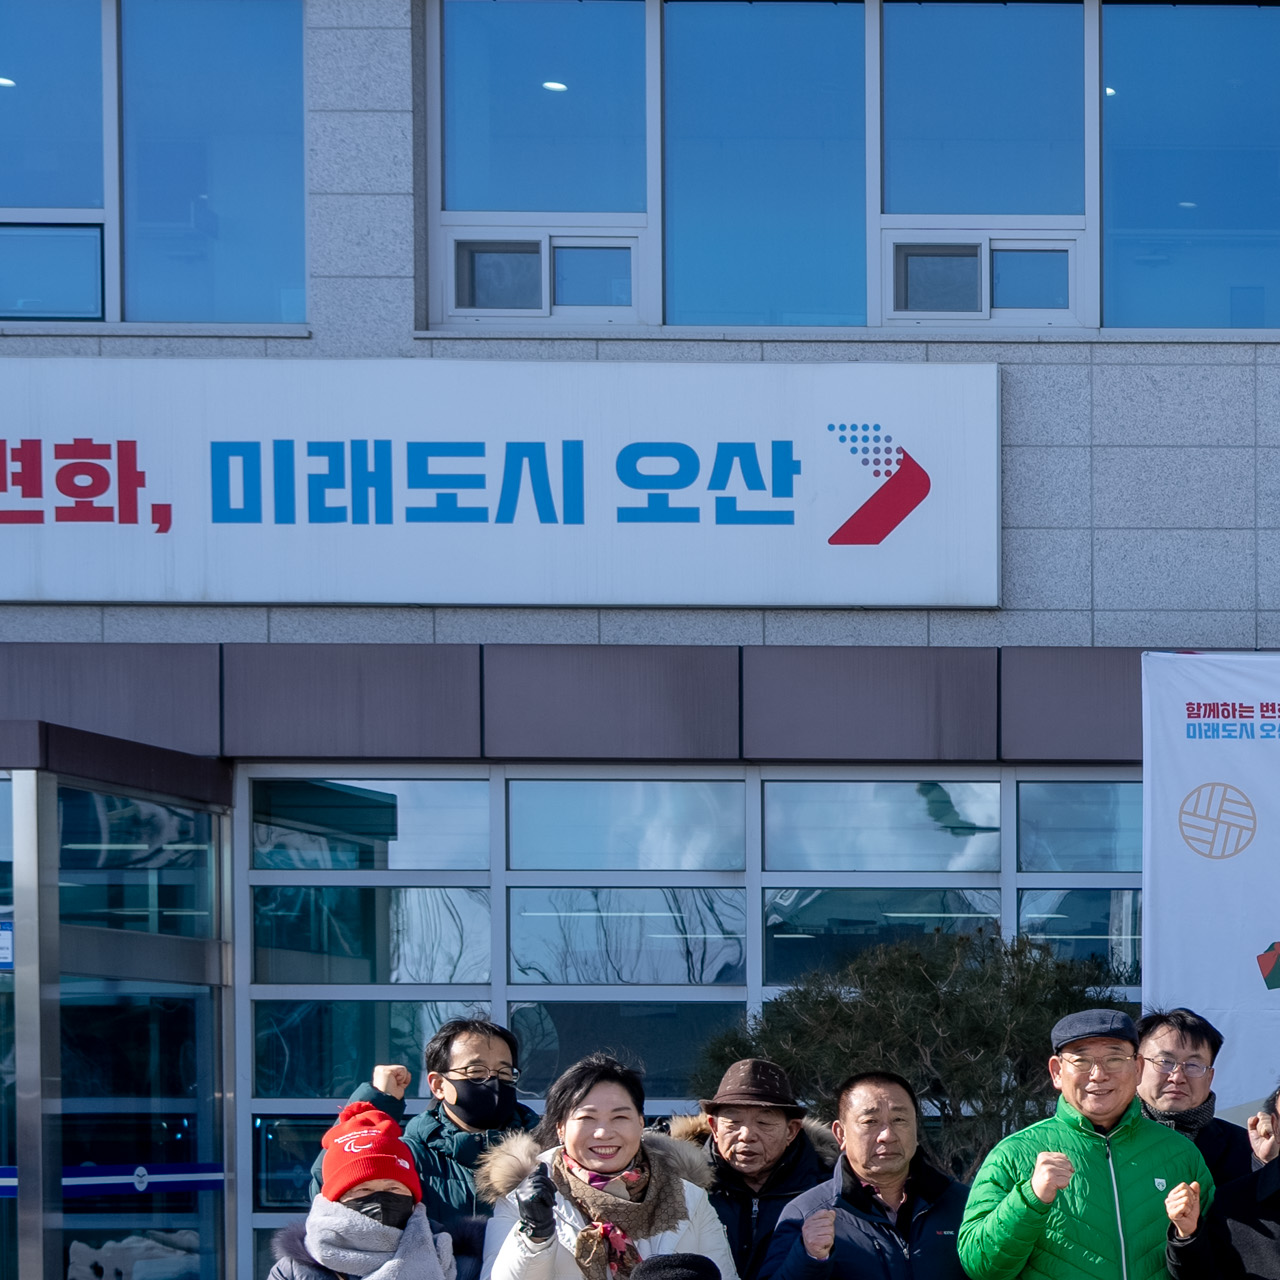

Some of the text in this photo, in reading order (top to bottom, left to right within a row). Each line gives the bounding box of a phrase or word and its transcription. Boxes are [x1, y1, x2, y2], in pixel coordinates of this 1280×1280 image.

[210, 439, 586, 526] 미래도시
[615, 440, 802, 526] 오산
[1185, 702, 1255, 719] 함께하는
[1186, 722, 1255, 740] 미래도시
